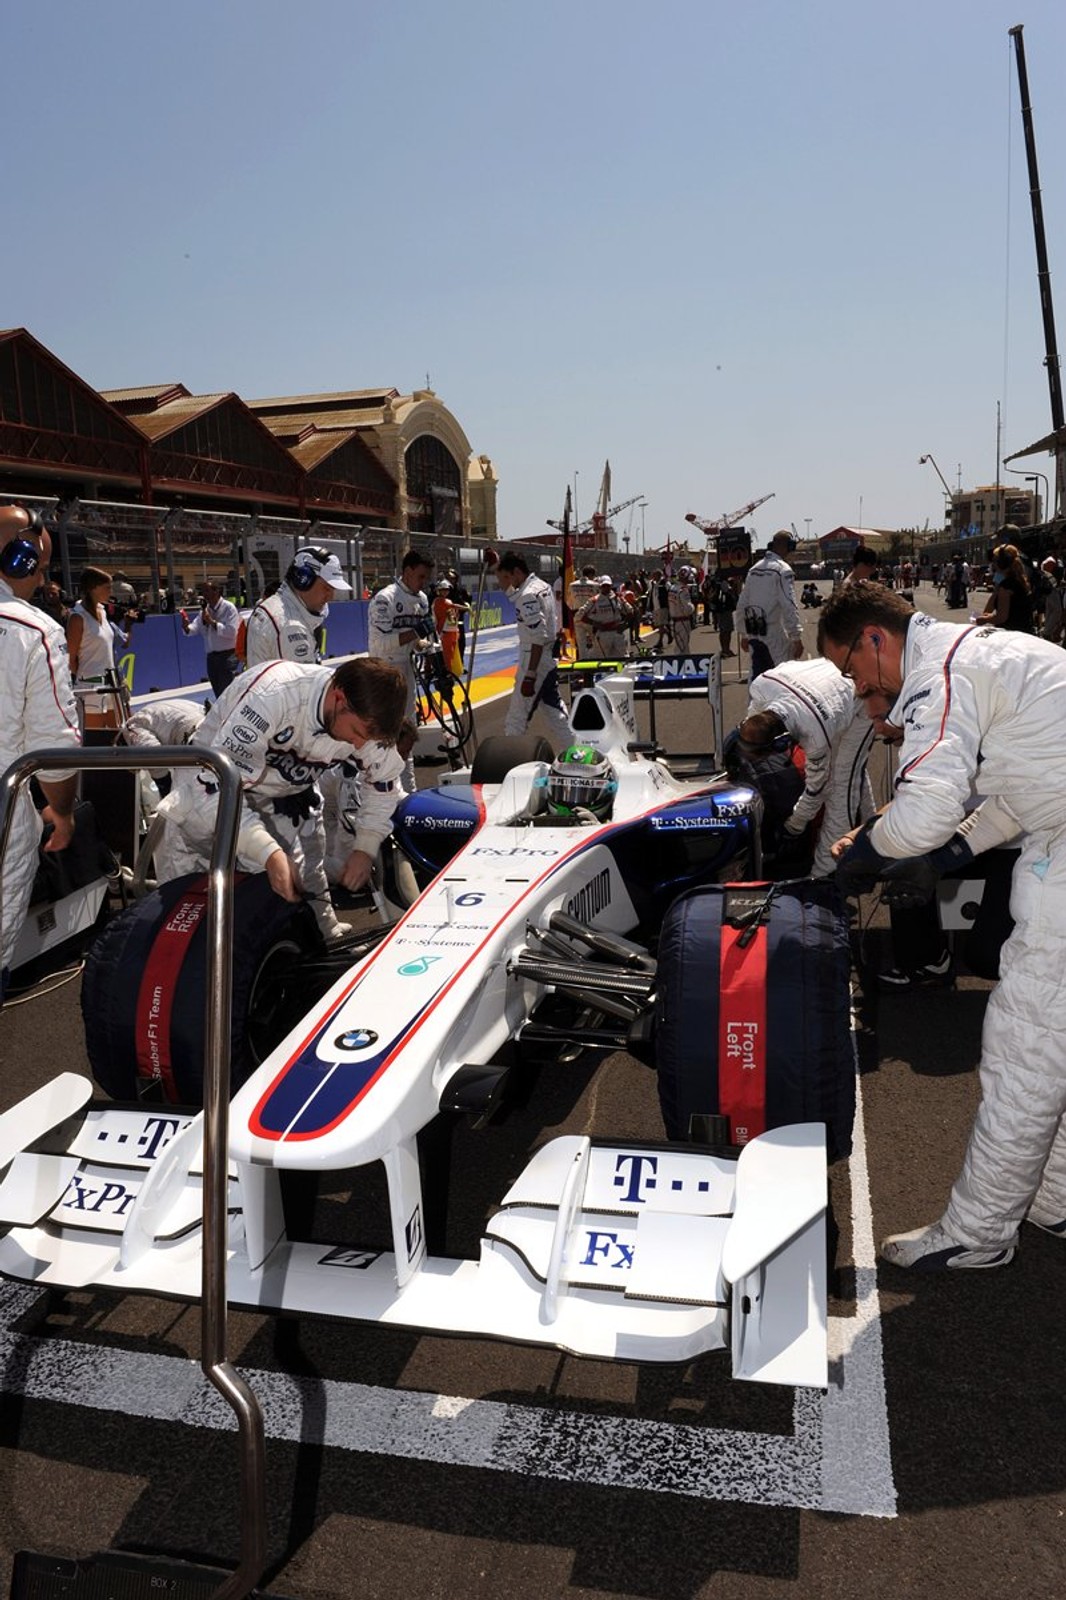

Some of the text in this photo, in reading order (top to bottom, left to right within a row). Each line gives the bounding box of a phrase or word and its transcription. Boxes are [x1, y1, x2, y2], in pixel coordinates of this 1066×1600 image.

[240, 704, 270, 734] SYNTIUM
[222, 737, 253, 759] FxPro
[470, 847, 560, 857] FxPro
[454, 892, 487, 907] 6
[166, 902, 193, 932] Front
[177, 903, 204, 933] Right
[147, 985, 163, 1080] Sauber F1 Team
[726, 1022, 742, 1058] Left
[742, 1022, 759, 1070] Front
[150, 1576, 177, 1591] BOX 2
